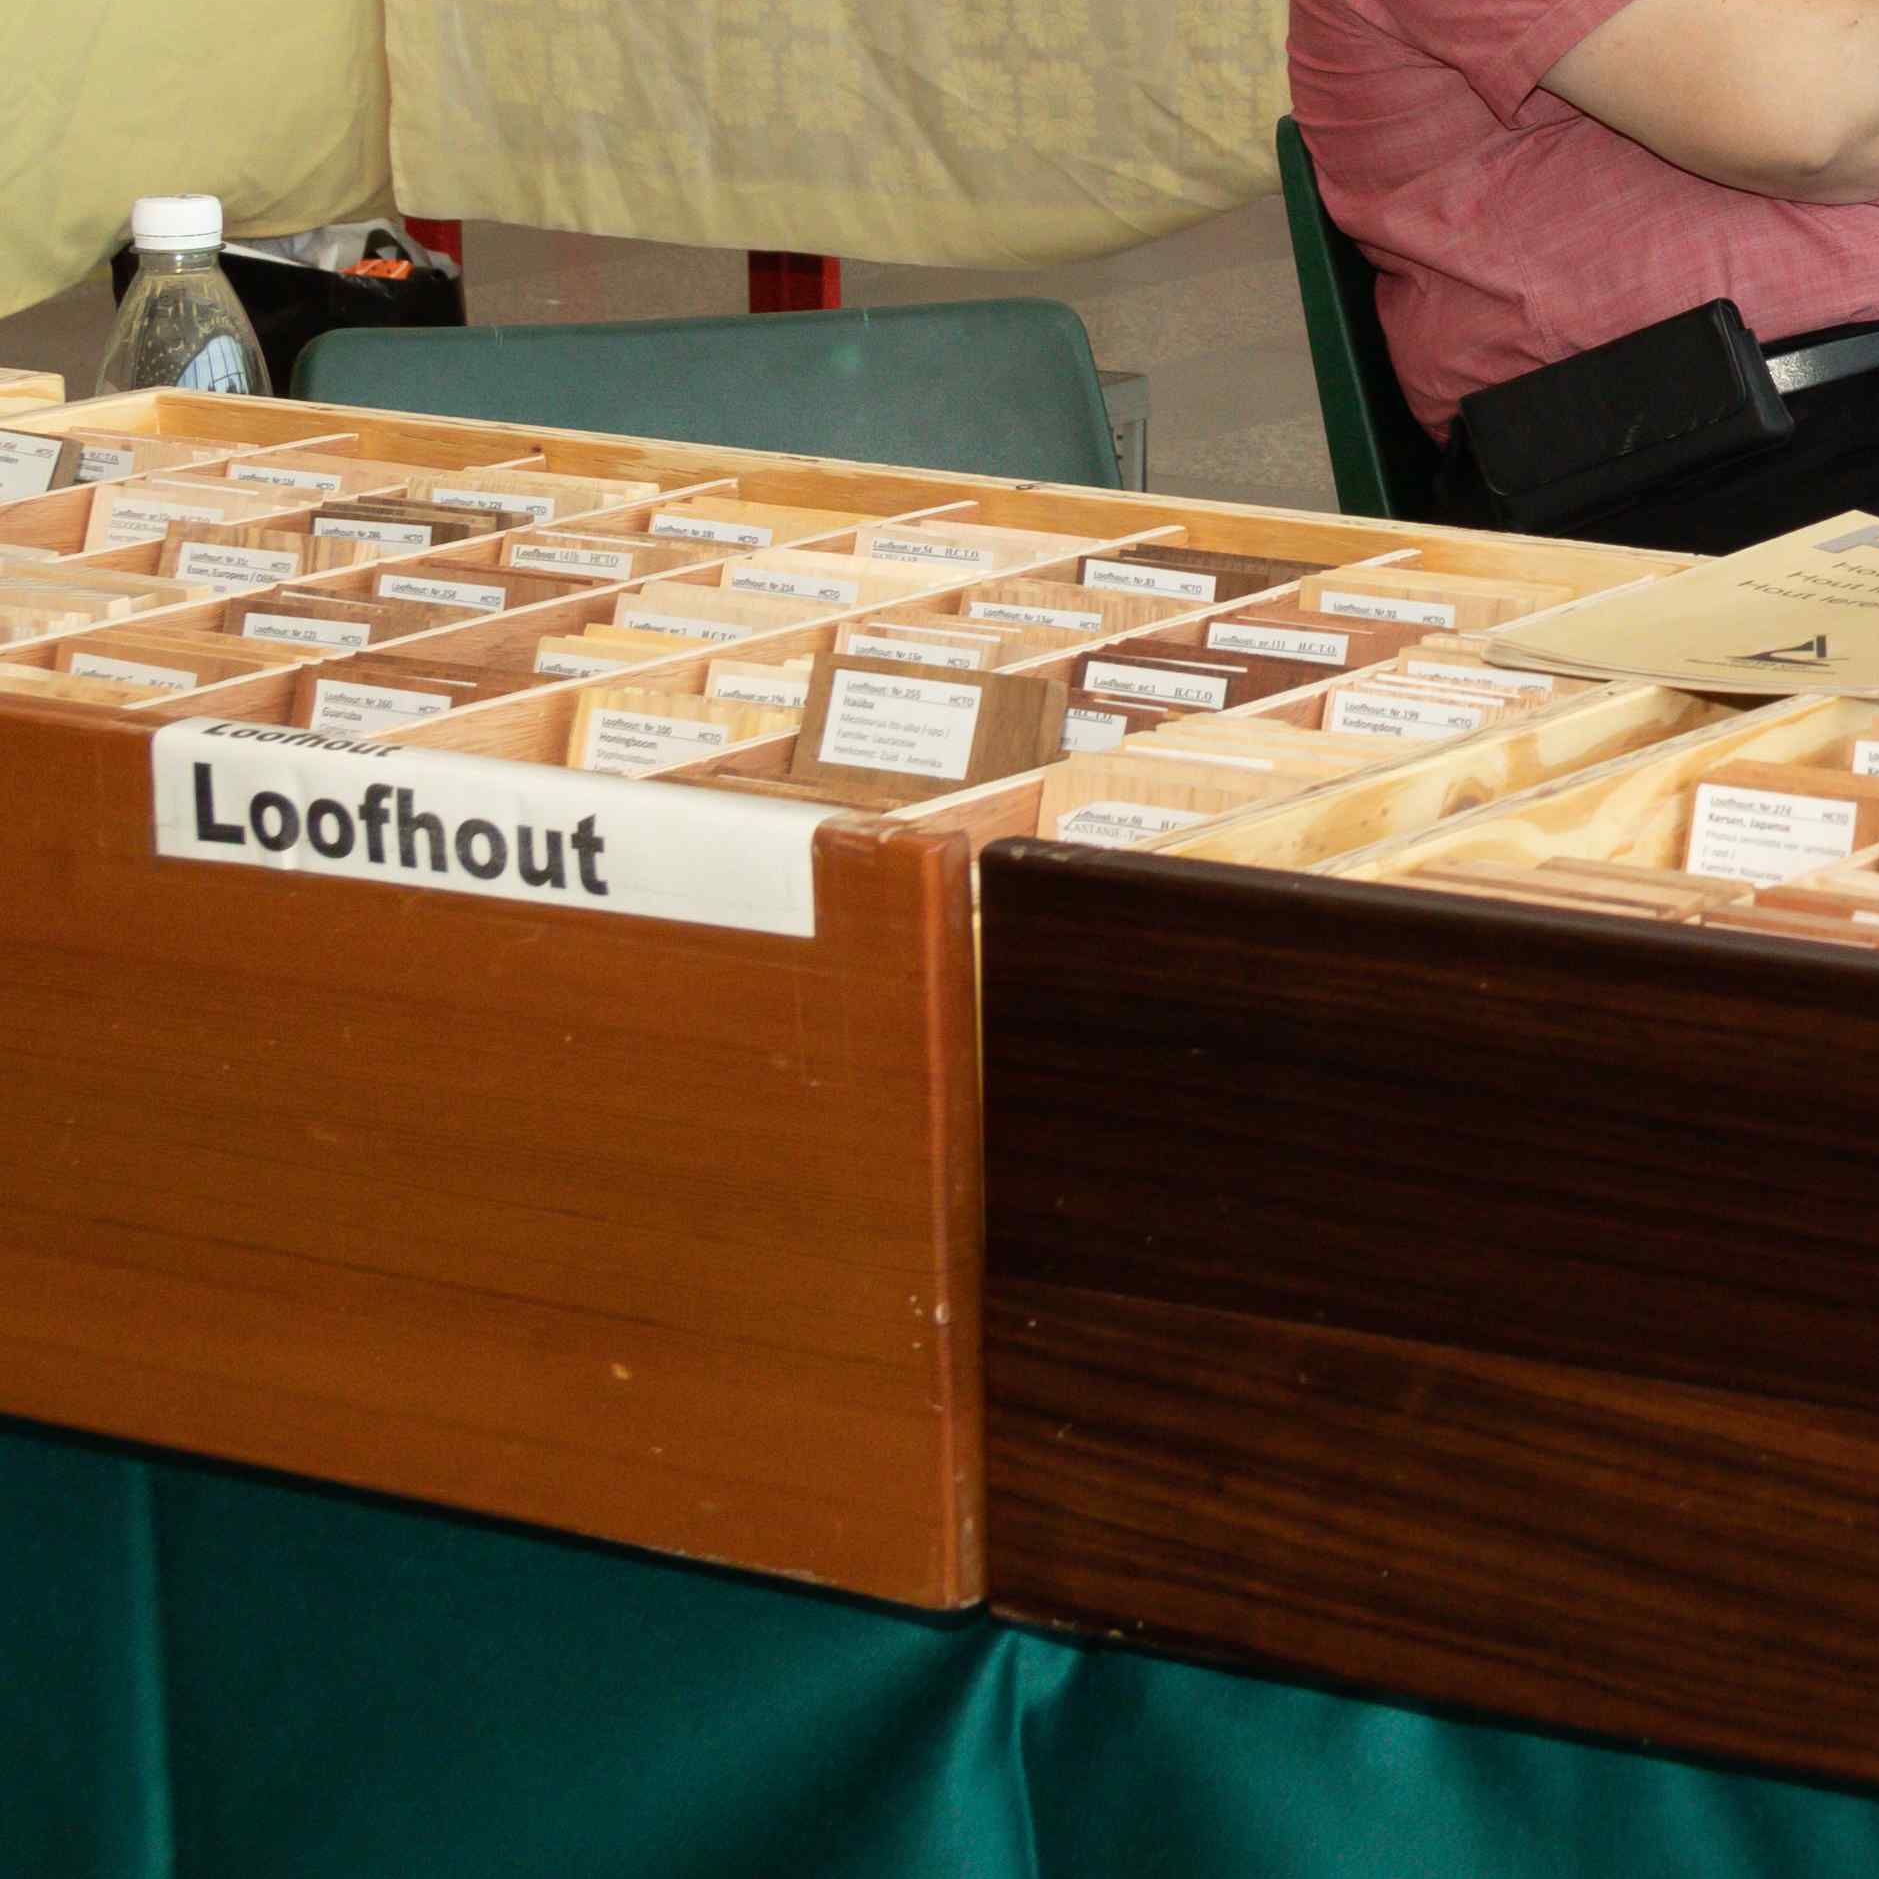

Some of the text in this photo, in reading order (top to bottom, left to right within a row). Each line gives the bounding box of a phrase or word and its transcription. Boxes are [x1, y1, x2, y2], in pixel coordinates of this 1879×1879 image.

[526, 505, 547, 515] HCTO
[403, 533, 424, 544] HCTO
[737, 534, 759, 544] HCTO
[1093, 570, 1132, 583] Loofhout:
[1180, 583, 1203, 595] HCTO
[1738, 579, 1817, 600] Hout
[1786, 571, 1865, 591] Hout
[480, 594, 501, 606] HCTO
[818, 588, 841, 600] HCTO
[1333, 601, 1373, 615] Loofhout:
[1421, 615, 1446, 626] HCTO
[1213, 633, 1255, 647] Loofhout:
[1093, 675, 1136, 690] Loofhout:
[323, 691, 362, 705] Loofhout:
[847, 681, 975, 708] Loofhout: Nr.255 HCTO
[1345, 699, 1387, 715] Loofhout:
[1447, 716, 1473, 730] HCTO
[200, 722, 405, 758] Loofhout
[601, 717, 722, 744] Loofhout: HCTO
[1710, 795, 1849, 825] Loofhout: HCTO
[192, 761, 609, 896] Loofhout
